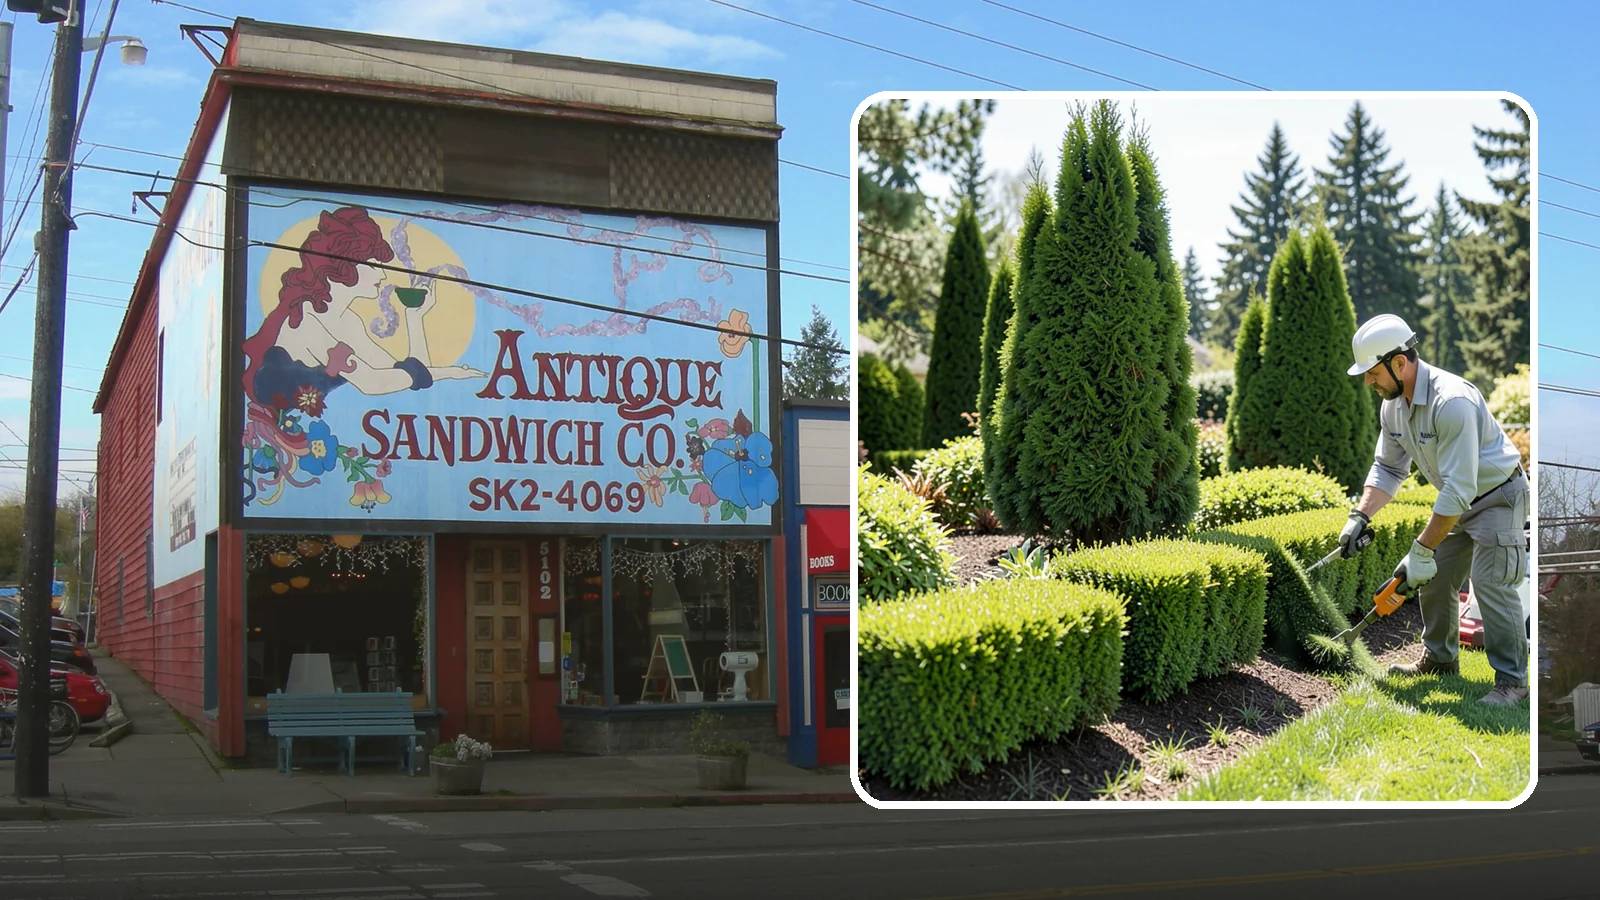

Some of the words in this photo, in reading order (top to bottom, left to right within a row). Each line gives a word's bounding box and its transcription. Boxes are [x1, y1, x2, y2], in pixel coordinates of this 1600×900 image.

[476, 329, 723, 420] ANTIQUE
[361, 408, 604, 467] SANDWICH
[617, 422, 685, 468] CO.
[468, 477, 645, 513] SK2-4069
[540, 541, 551, 600] 5102
[809, 555, 835, 569] BOOKS
